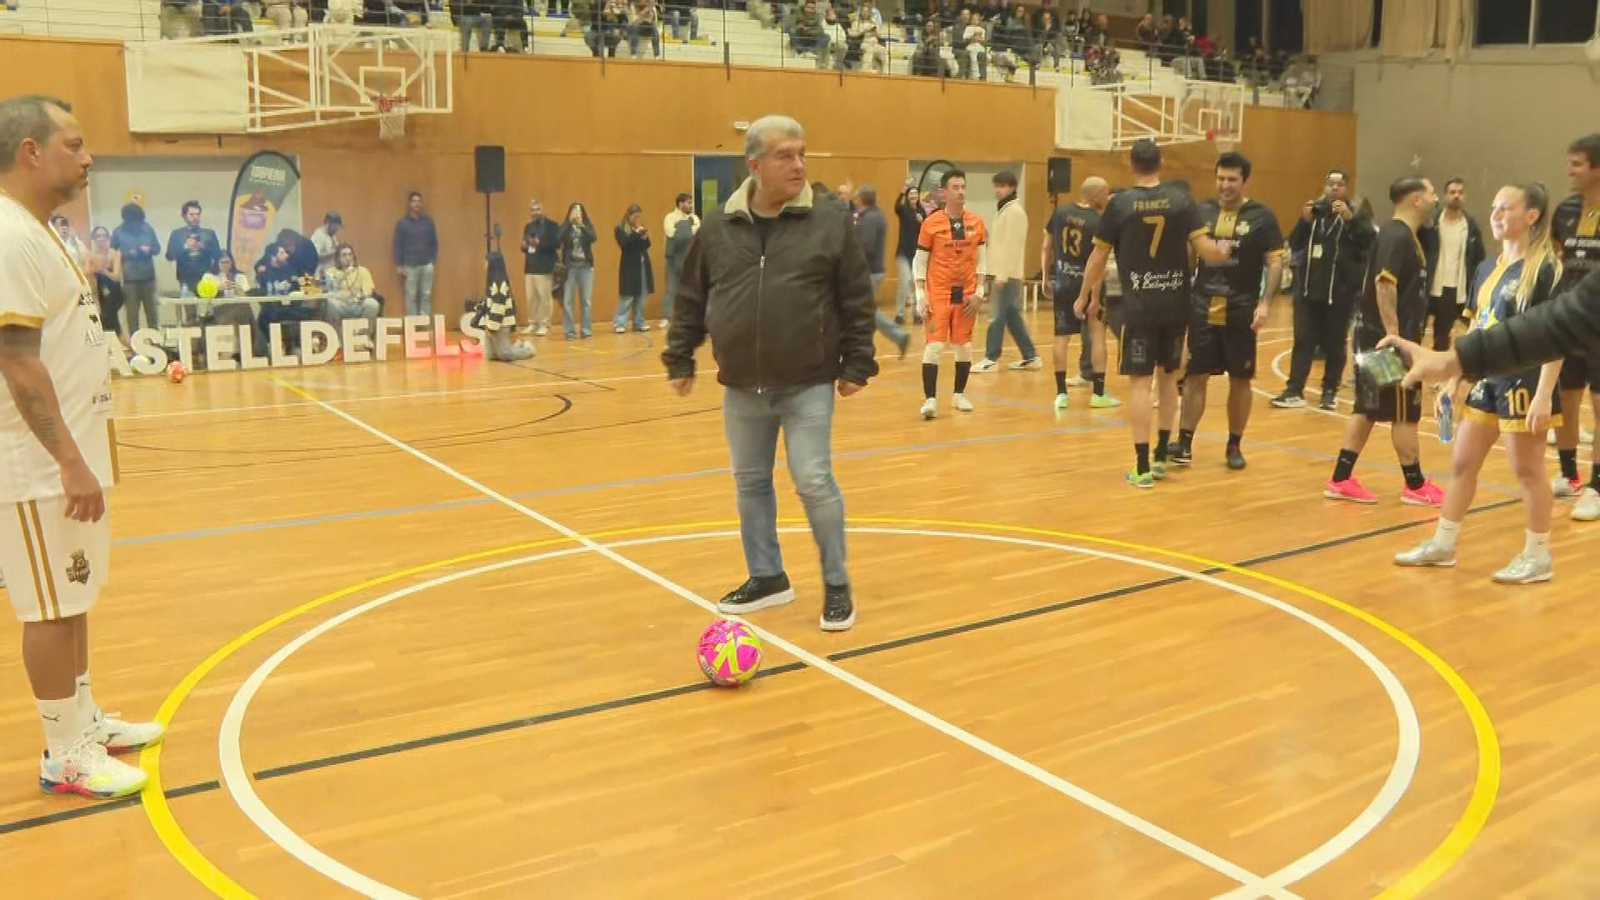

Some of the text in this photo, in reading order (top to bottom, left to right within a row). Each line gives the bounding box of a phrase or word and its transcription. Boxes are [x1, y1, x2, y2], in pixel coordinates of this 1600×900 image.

[1062, 226, 1083, 257] 13
[1142, 215, 1166, 259] 7
[104, 312, 485, 377] ASTELLDEFELS
[1504, 388, 1530, 416] 10
